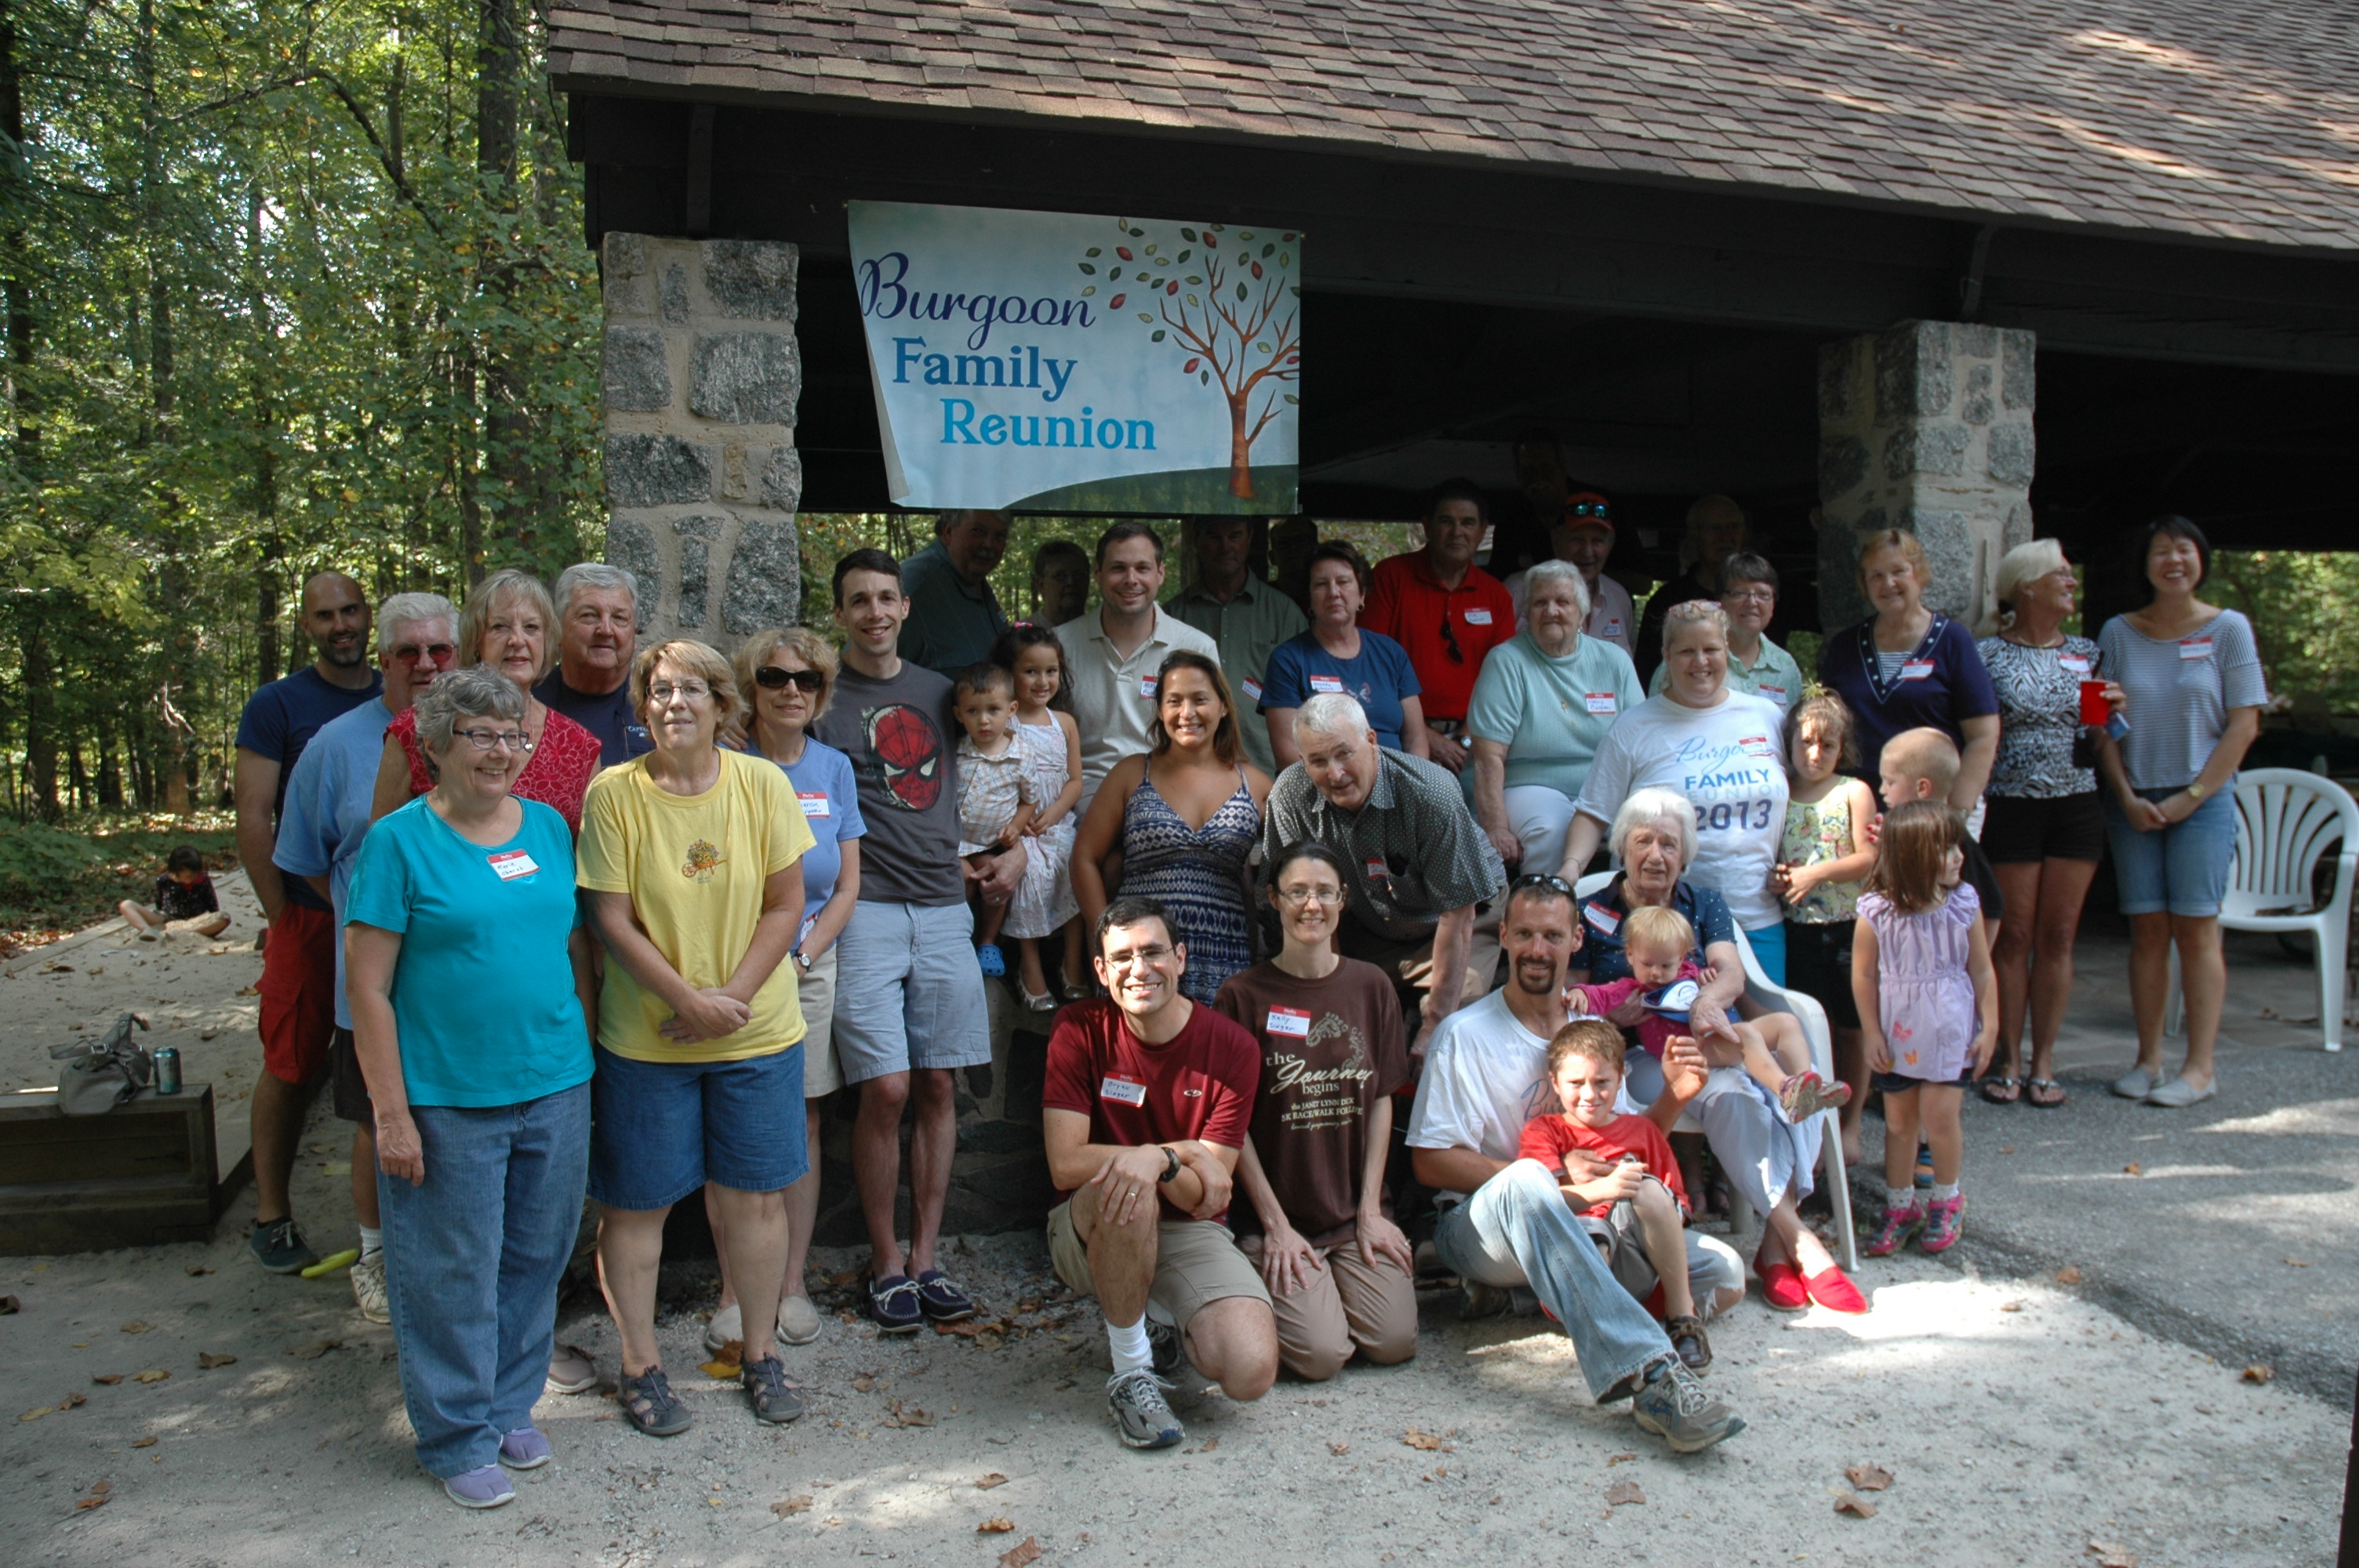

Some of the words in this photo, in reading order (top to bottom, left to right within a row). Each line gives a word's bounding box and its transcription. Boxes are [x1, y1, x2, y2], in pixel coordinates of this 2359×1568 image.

[859, 251, 1096, 351] Burgoon
[891, 336, 1078, 403] Family
[940, 397, 1158, 451] Reunion
[1675, 735, 1745, 774] Burgo
[1685, 769, 1769, 790] FAMILY
[1686, 783, 1786, 802] EUNION
[1695, 799, 1773, 832] 2013
[1271, 1014, 1290, 1025] Kelly
[1265, 1051, 1296, 1066] the
[1270, 1059, 1373, 1094] Journey
[1302, 1080, 1339, 1096] begins
